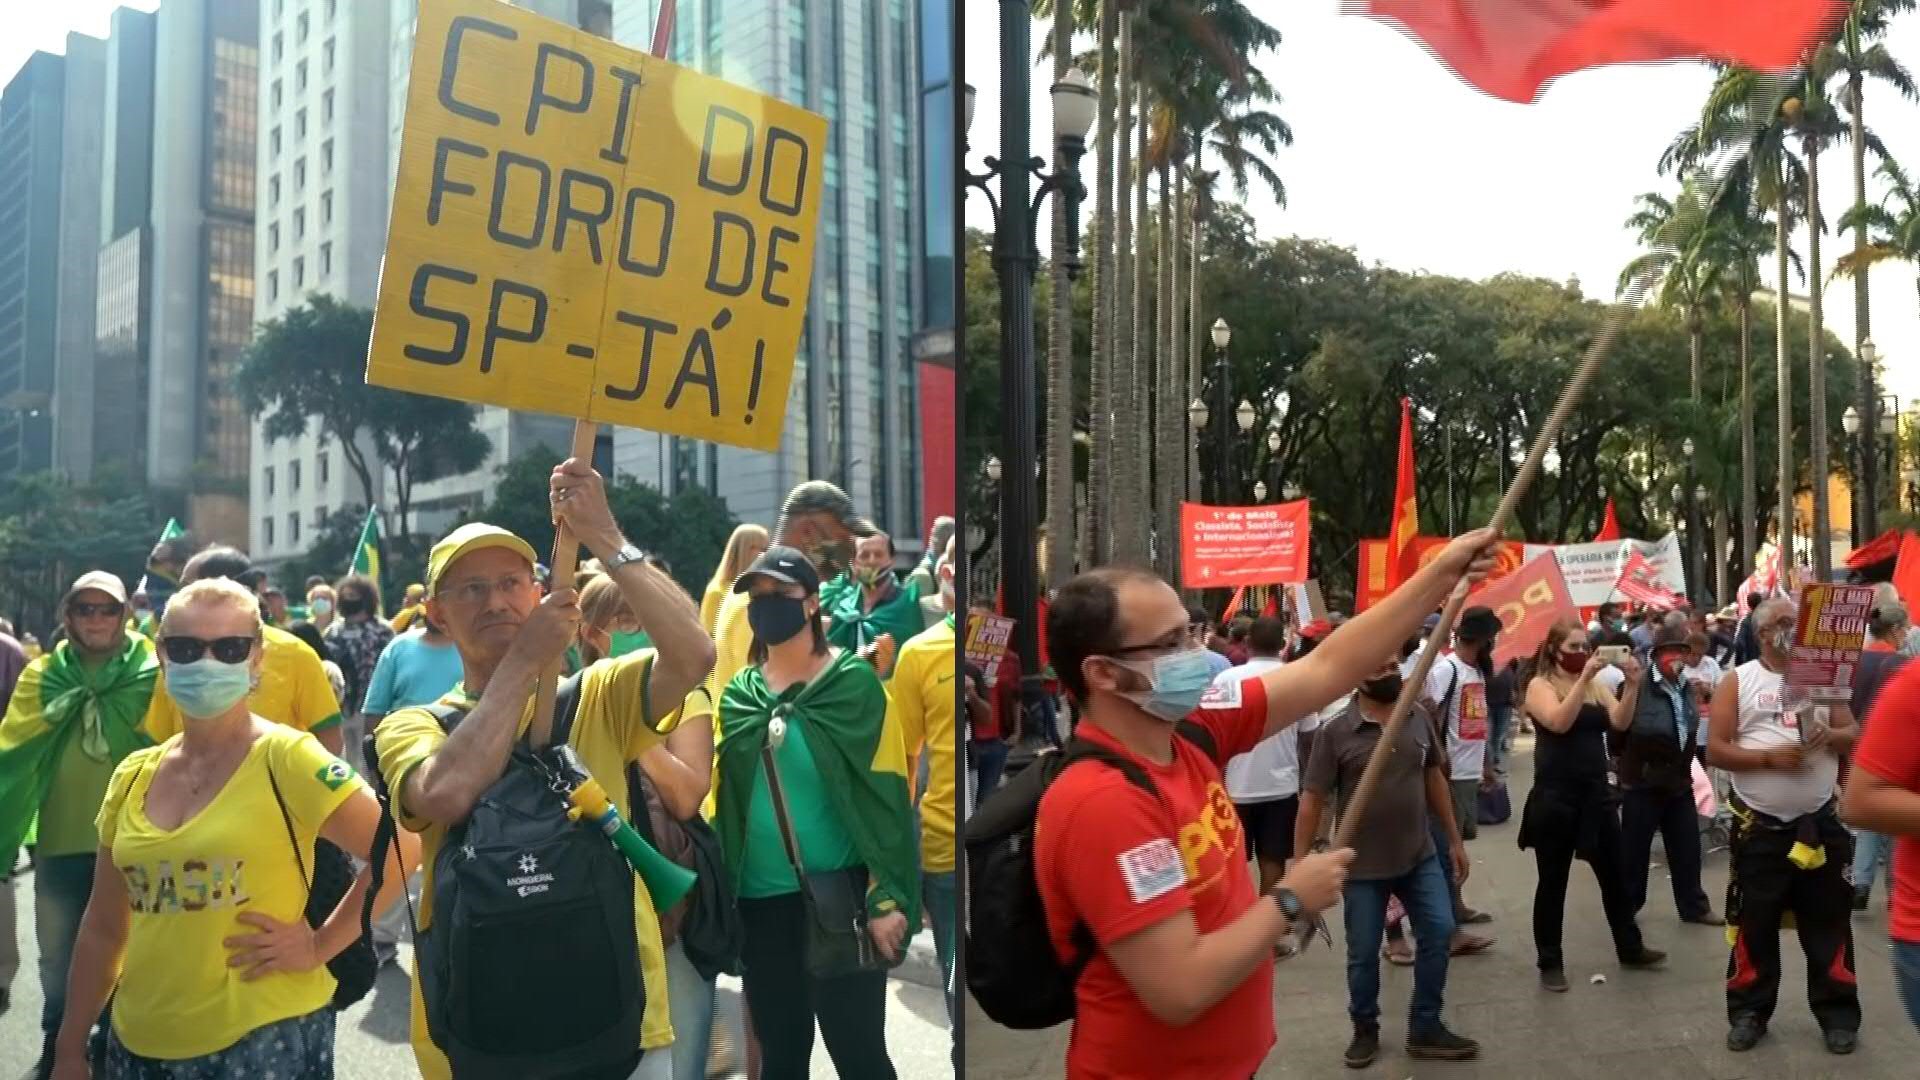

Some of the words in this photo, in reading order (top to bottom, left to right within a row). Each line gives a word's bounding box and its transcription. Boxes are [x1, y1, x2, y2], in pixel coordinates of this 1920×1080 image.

[438, 15, 641, 164] CPI
[698, 104, 808, 216] DO
[427, 137, 674, 277] FORO
[705, 211, 800, 307] DE
[1835, 616, 1865, 634] LUTA
